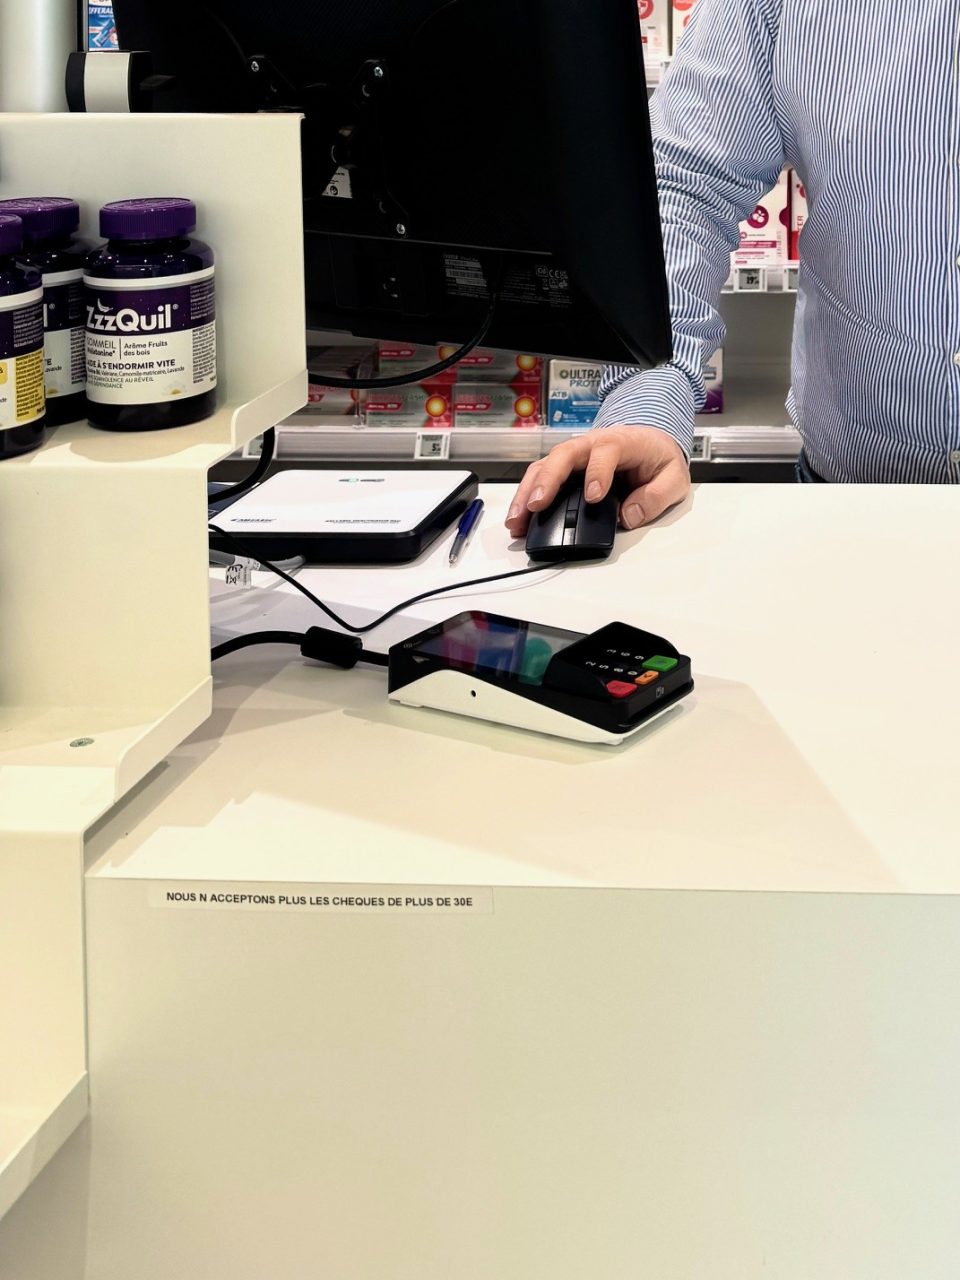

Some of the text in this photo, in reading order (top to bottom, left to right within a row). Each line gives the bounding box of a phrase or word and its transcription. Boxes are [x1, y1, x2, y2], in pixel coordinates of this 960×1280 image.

[86, 303, 172, 332] ZzzQuil
[123, 340, 168, 349] Arôme Fruits
[156, 358, 176, 368] VITE
[569, 369, 602, 379] ULTRA
[569, 379, 603, 388] PROT
[166, 891, 473, 907] NOUS N ACCEPTONS PLUS LES CHEQUES DE PLUS DE 30E
